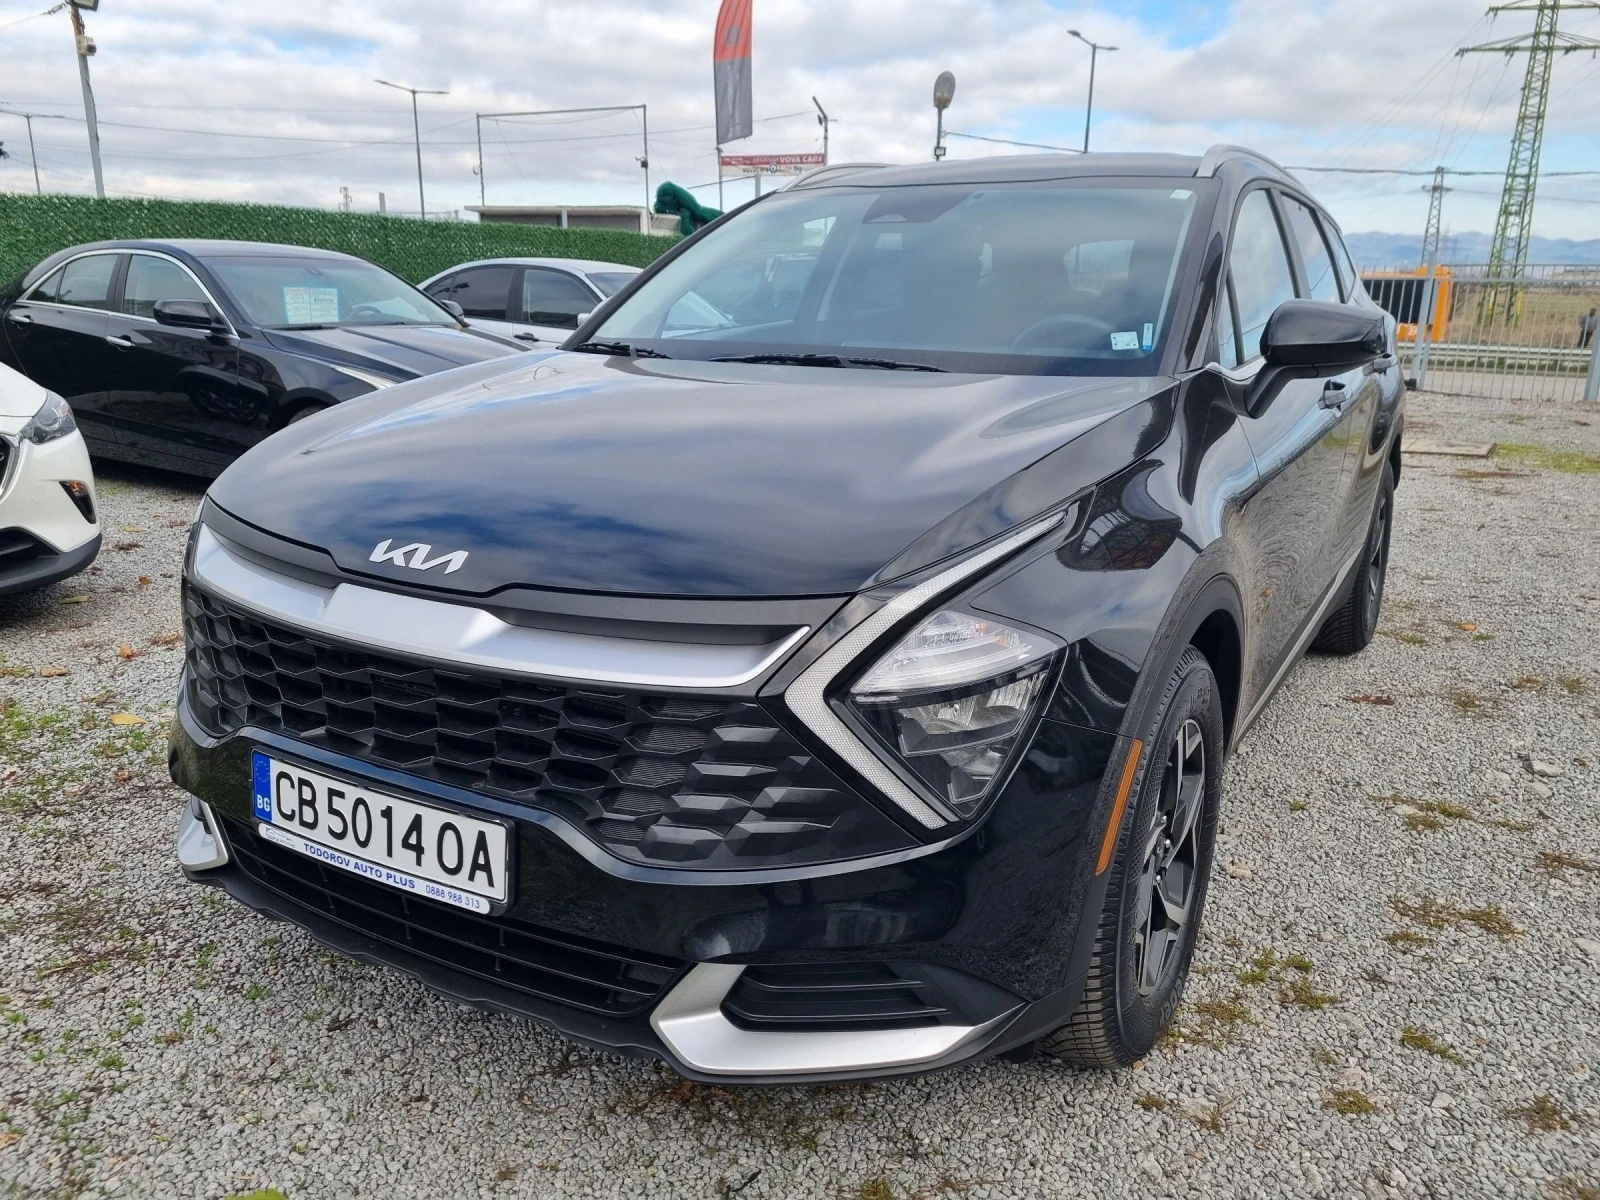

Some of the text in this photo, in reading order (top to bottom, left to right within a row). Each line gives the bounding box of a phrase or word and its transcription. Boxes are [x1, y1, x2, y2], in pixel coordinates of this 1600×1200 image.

[368, 538, 469, 575] KIA
[256, 795, 271, 812] BG
[303, 843, 480, 909] TODOROV AUTO PLUS 0888 988 313
